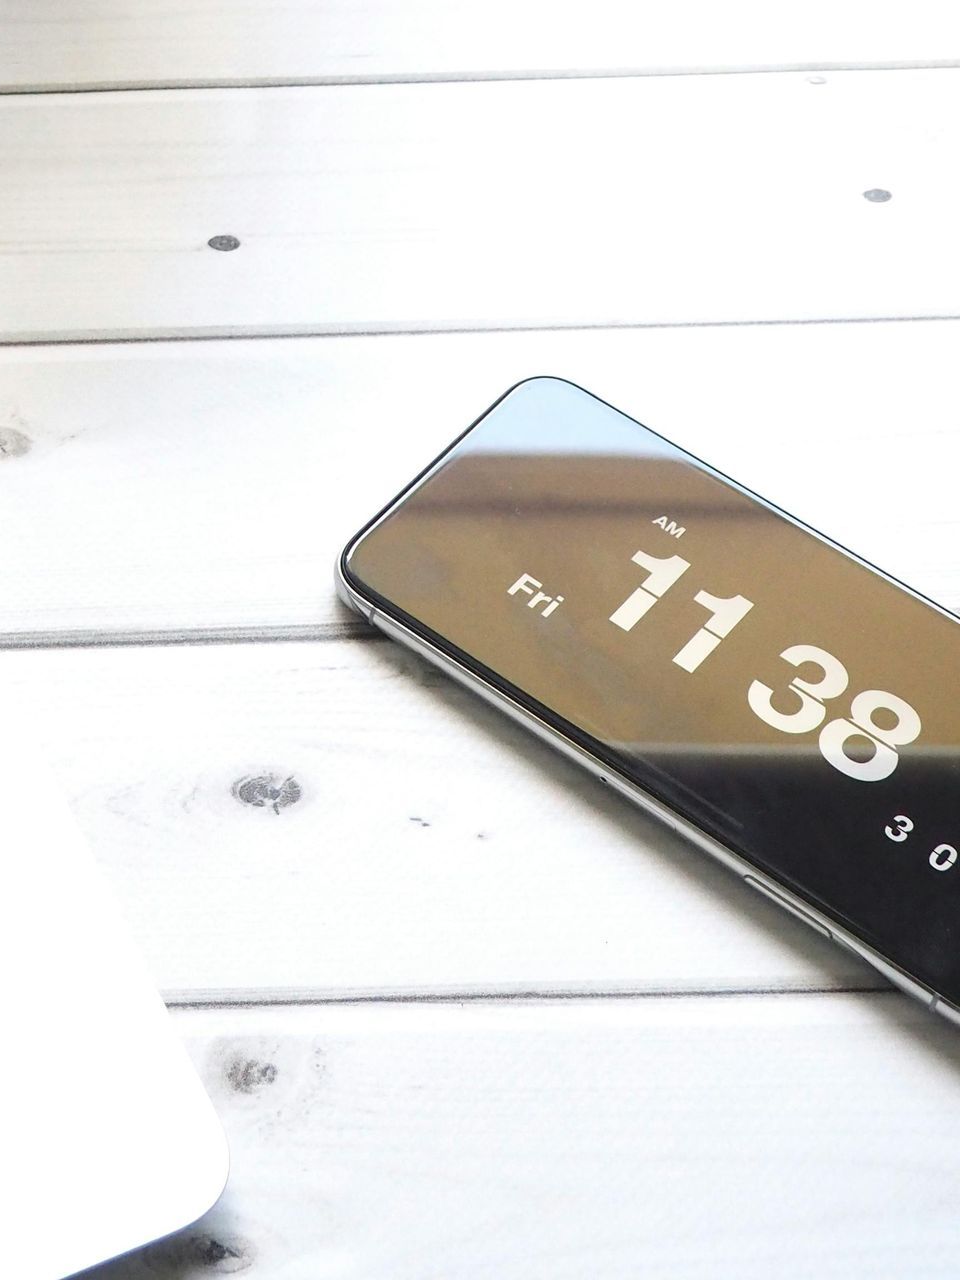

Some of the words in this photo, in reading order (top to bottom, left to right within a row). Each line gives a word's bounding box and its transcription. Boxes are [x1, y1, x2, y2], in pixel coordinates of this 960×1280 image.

[652, 516, 687, 539] AM
[506, 572, 564, 618] Fri
[747, 643, 923, 784] 38
